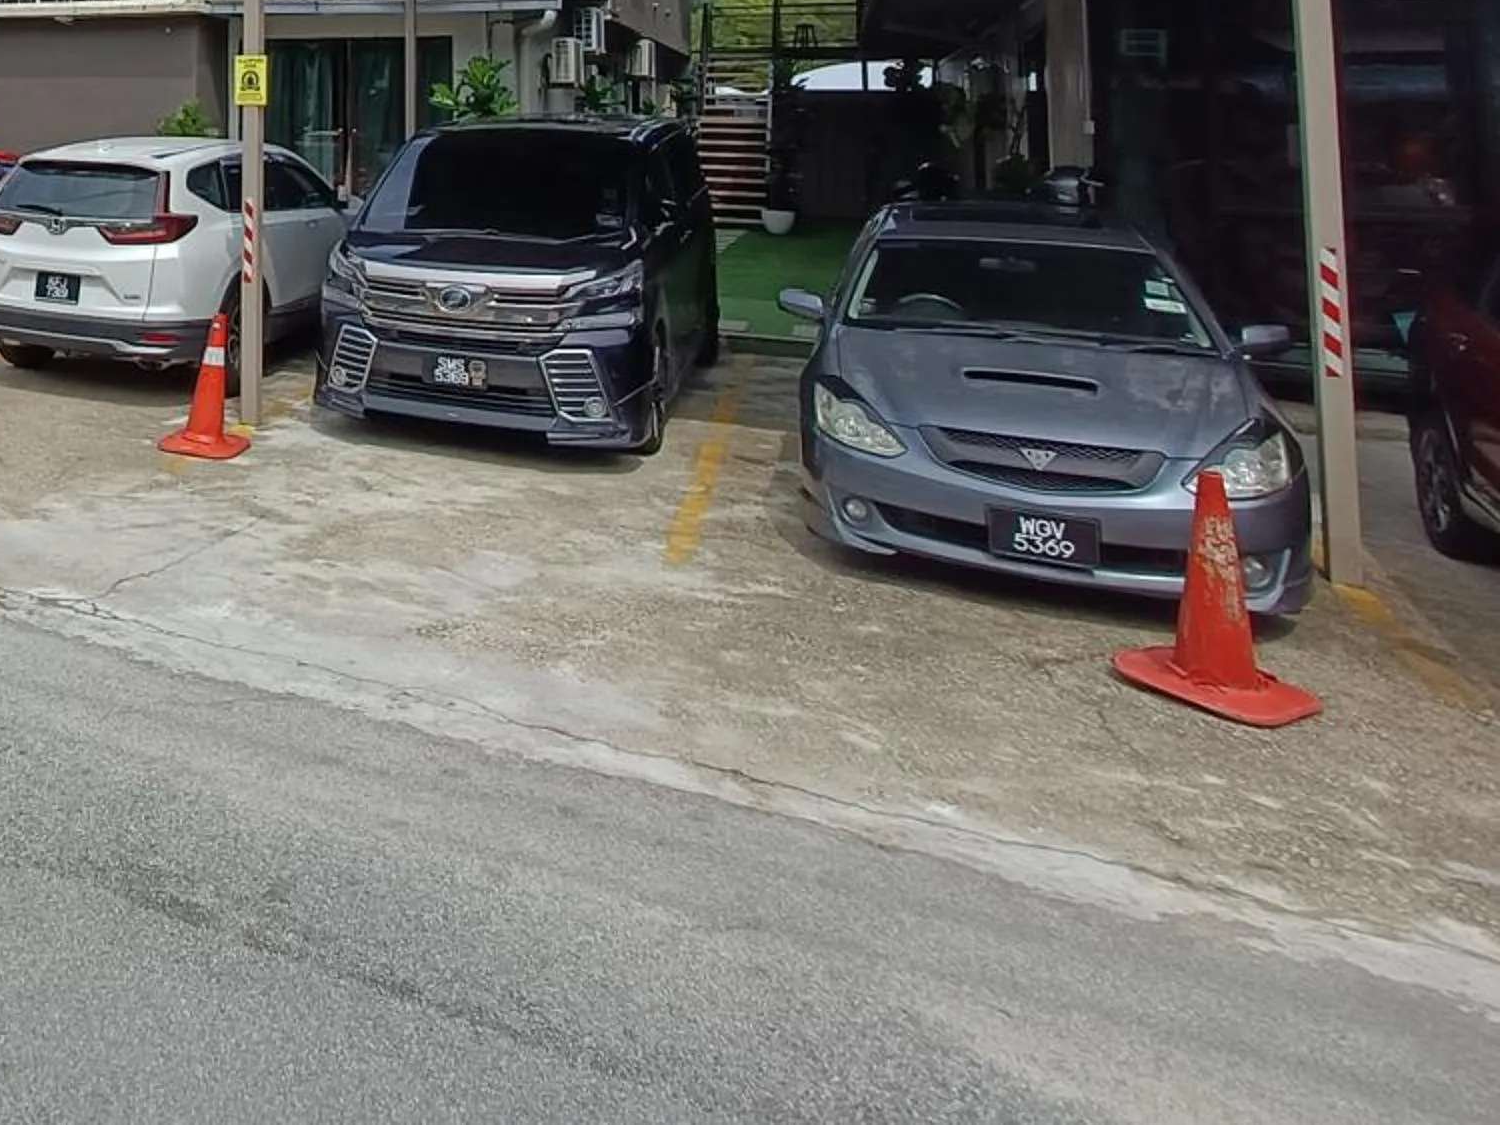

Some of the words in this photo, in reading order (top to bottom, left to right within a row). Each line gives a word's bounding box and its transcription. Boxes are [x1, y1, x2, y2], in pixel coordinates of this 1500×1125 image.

[434, 369, 469, 386] 5369
[1019, 516, 1066, 540] WGV
[1013, 533, 1075, 559] 5369
